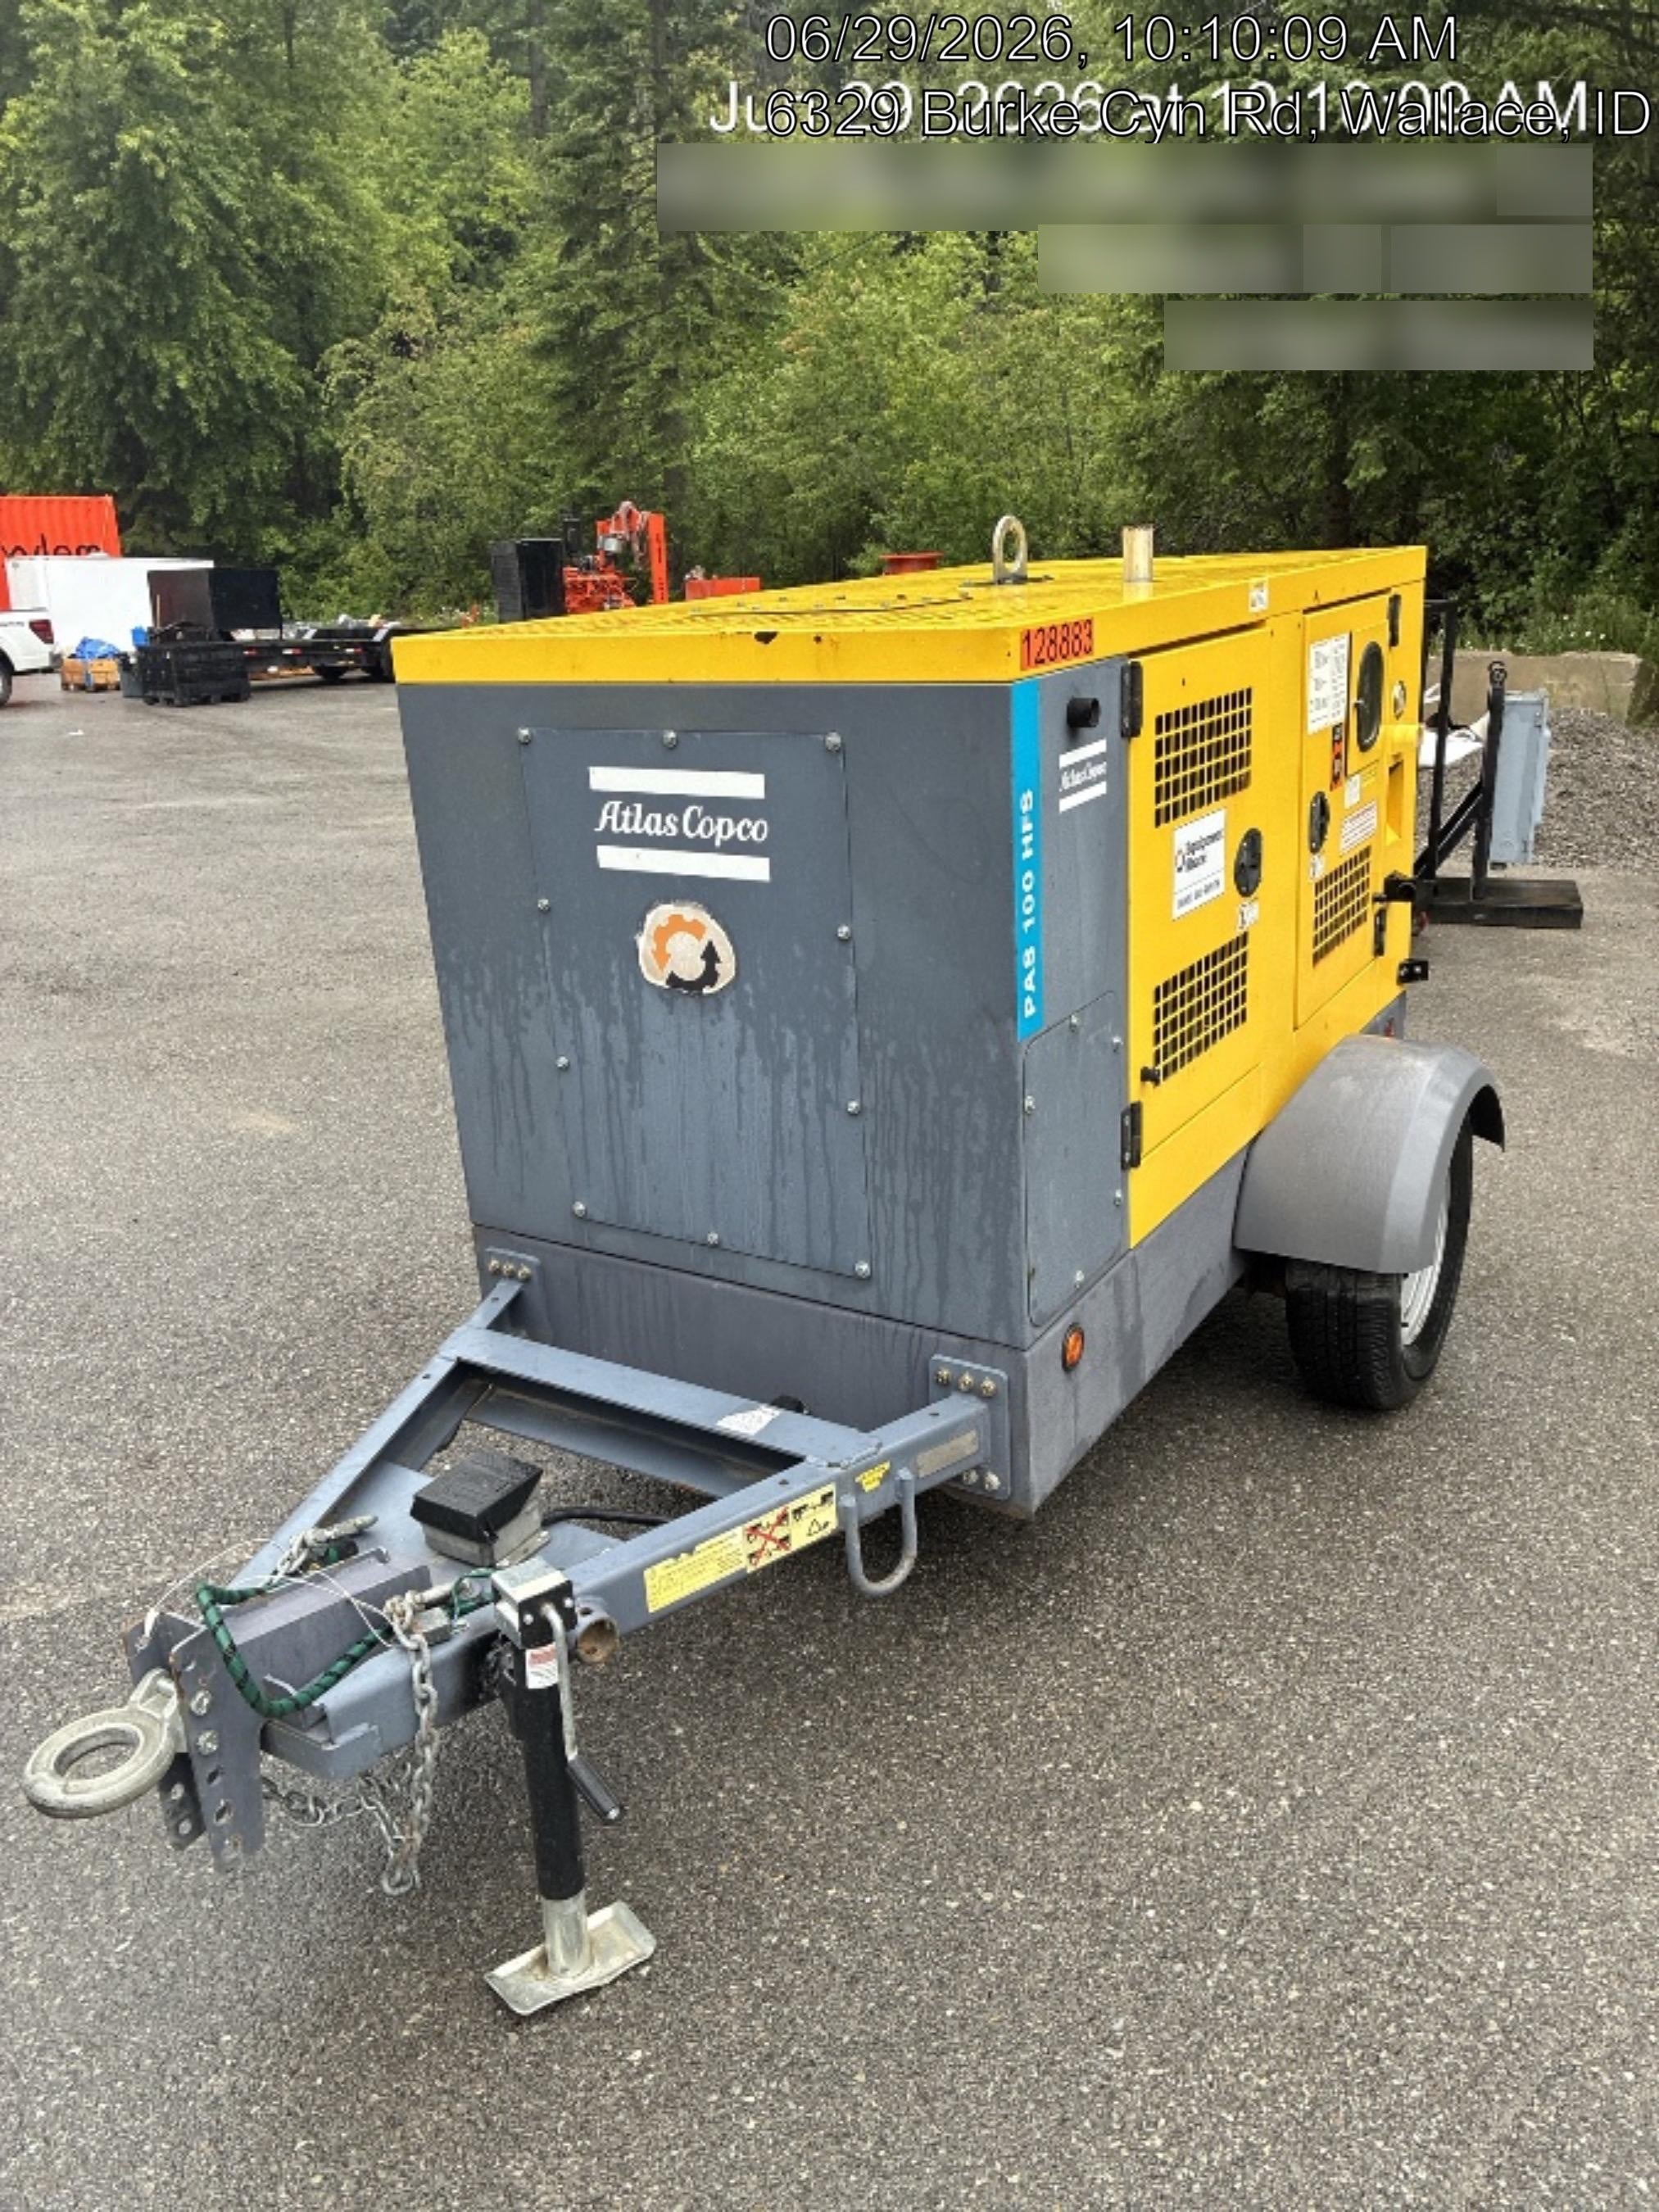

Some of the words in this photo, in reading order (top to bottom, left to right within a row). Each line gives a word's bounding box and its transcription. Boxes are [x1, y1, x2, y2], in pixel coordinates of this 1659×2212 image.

[1022, 619, 1092, 666] 128883
[594, 800, 678, 836] Atlas
[682, 805, 768, 847] Copco
[1022, 869, 1035, 933] 100
[1022, 945, 1036, 1018] PAS
